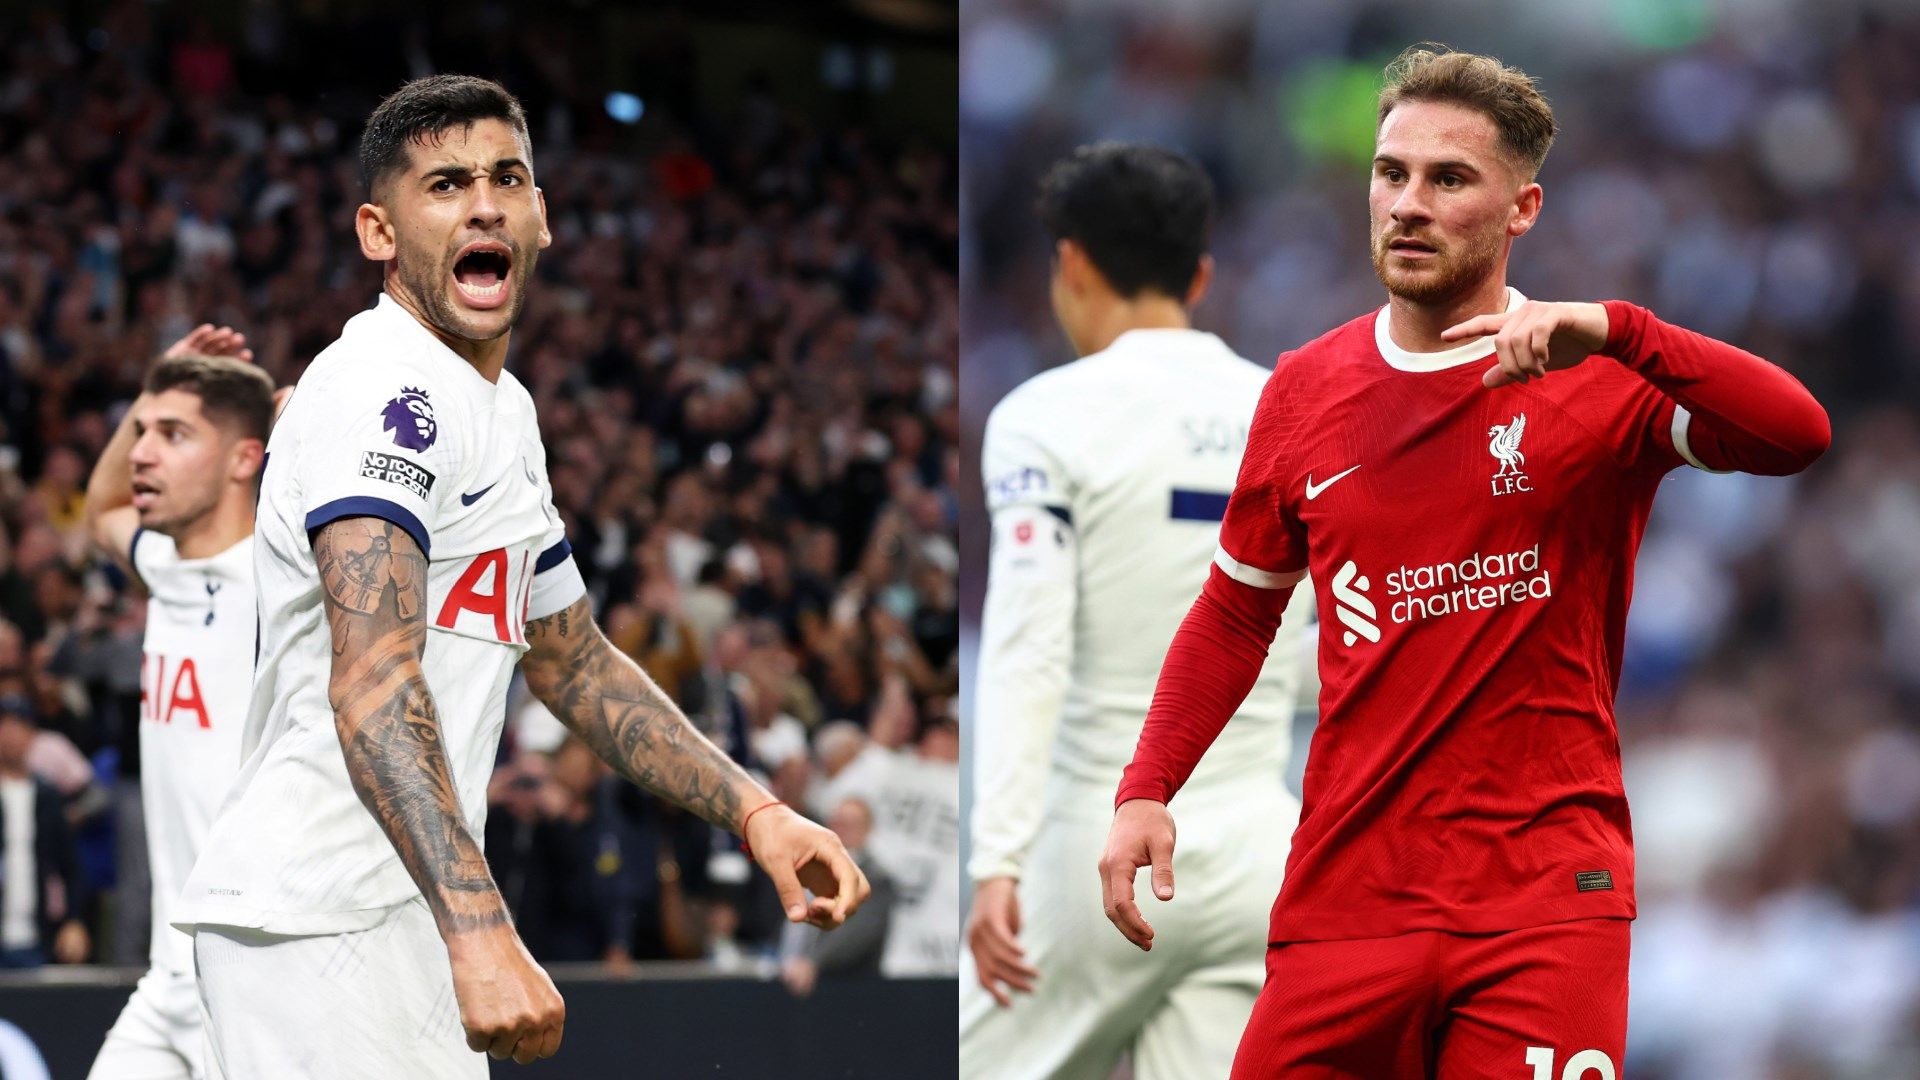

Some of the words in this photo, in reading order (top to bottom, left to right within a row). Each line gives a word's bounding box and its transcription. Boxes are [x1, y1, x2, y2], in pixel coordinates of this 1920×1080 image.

[360, 464, 385, 478] for
[386, 471, 428, 502] racism
[362, 451, 387, 468] No
[389, 458, 428, 486] room
[1491, 476, 1534, 496] L.F.C.
[1386, 543, 1539, 595] standard
[1391, 571, 1552, 624] chartered
